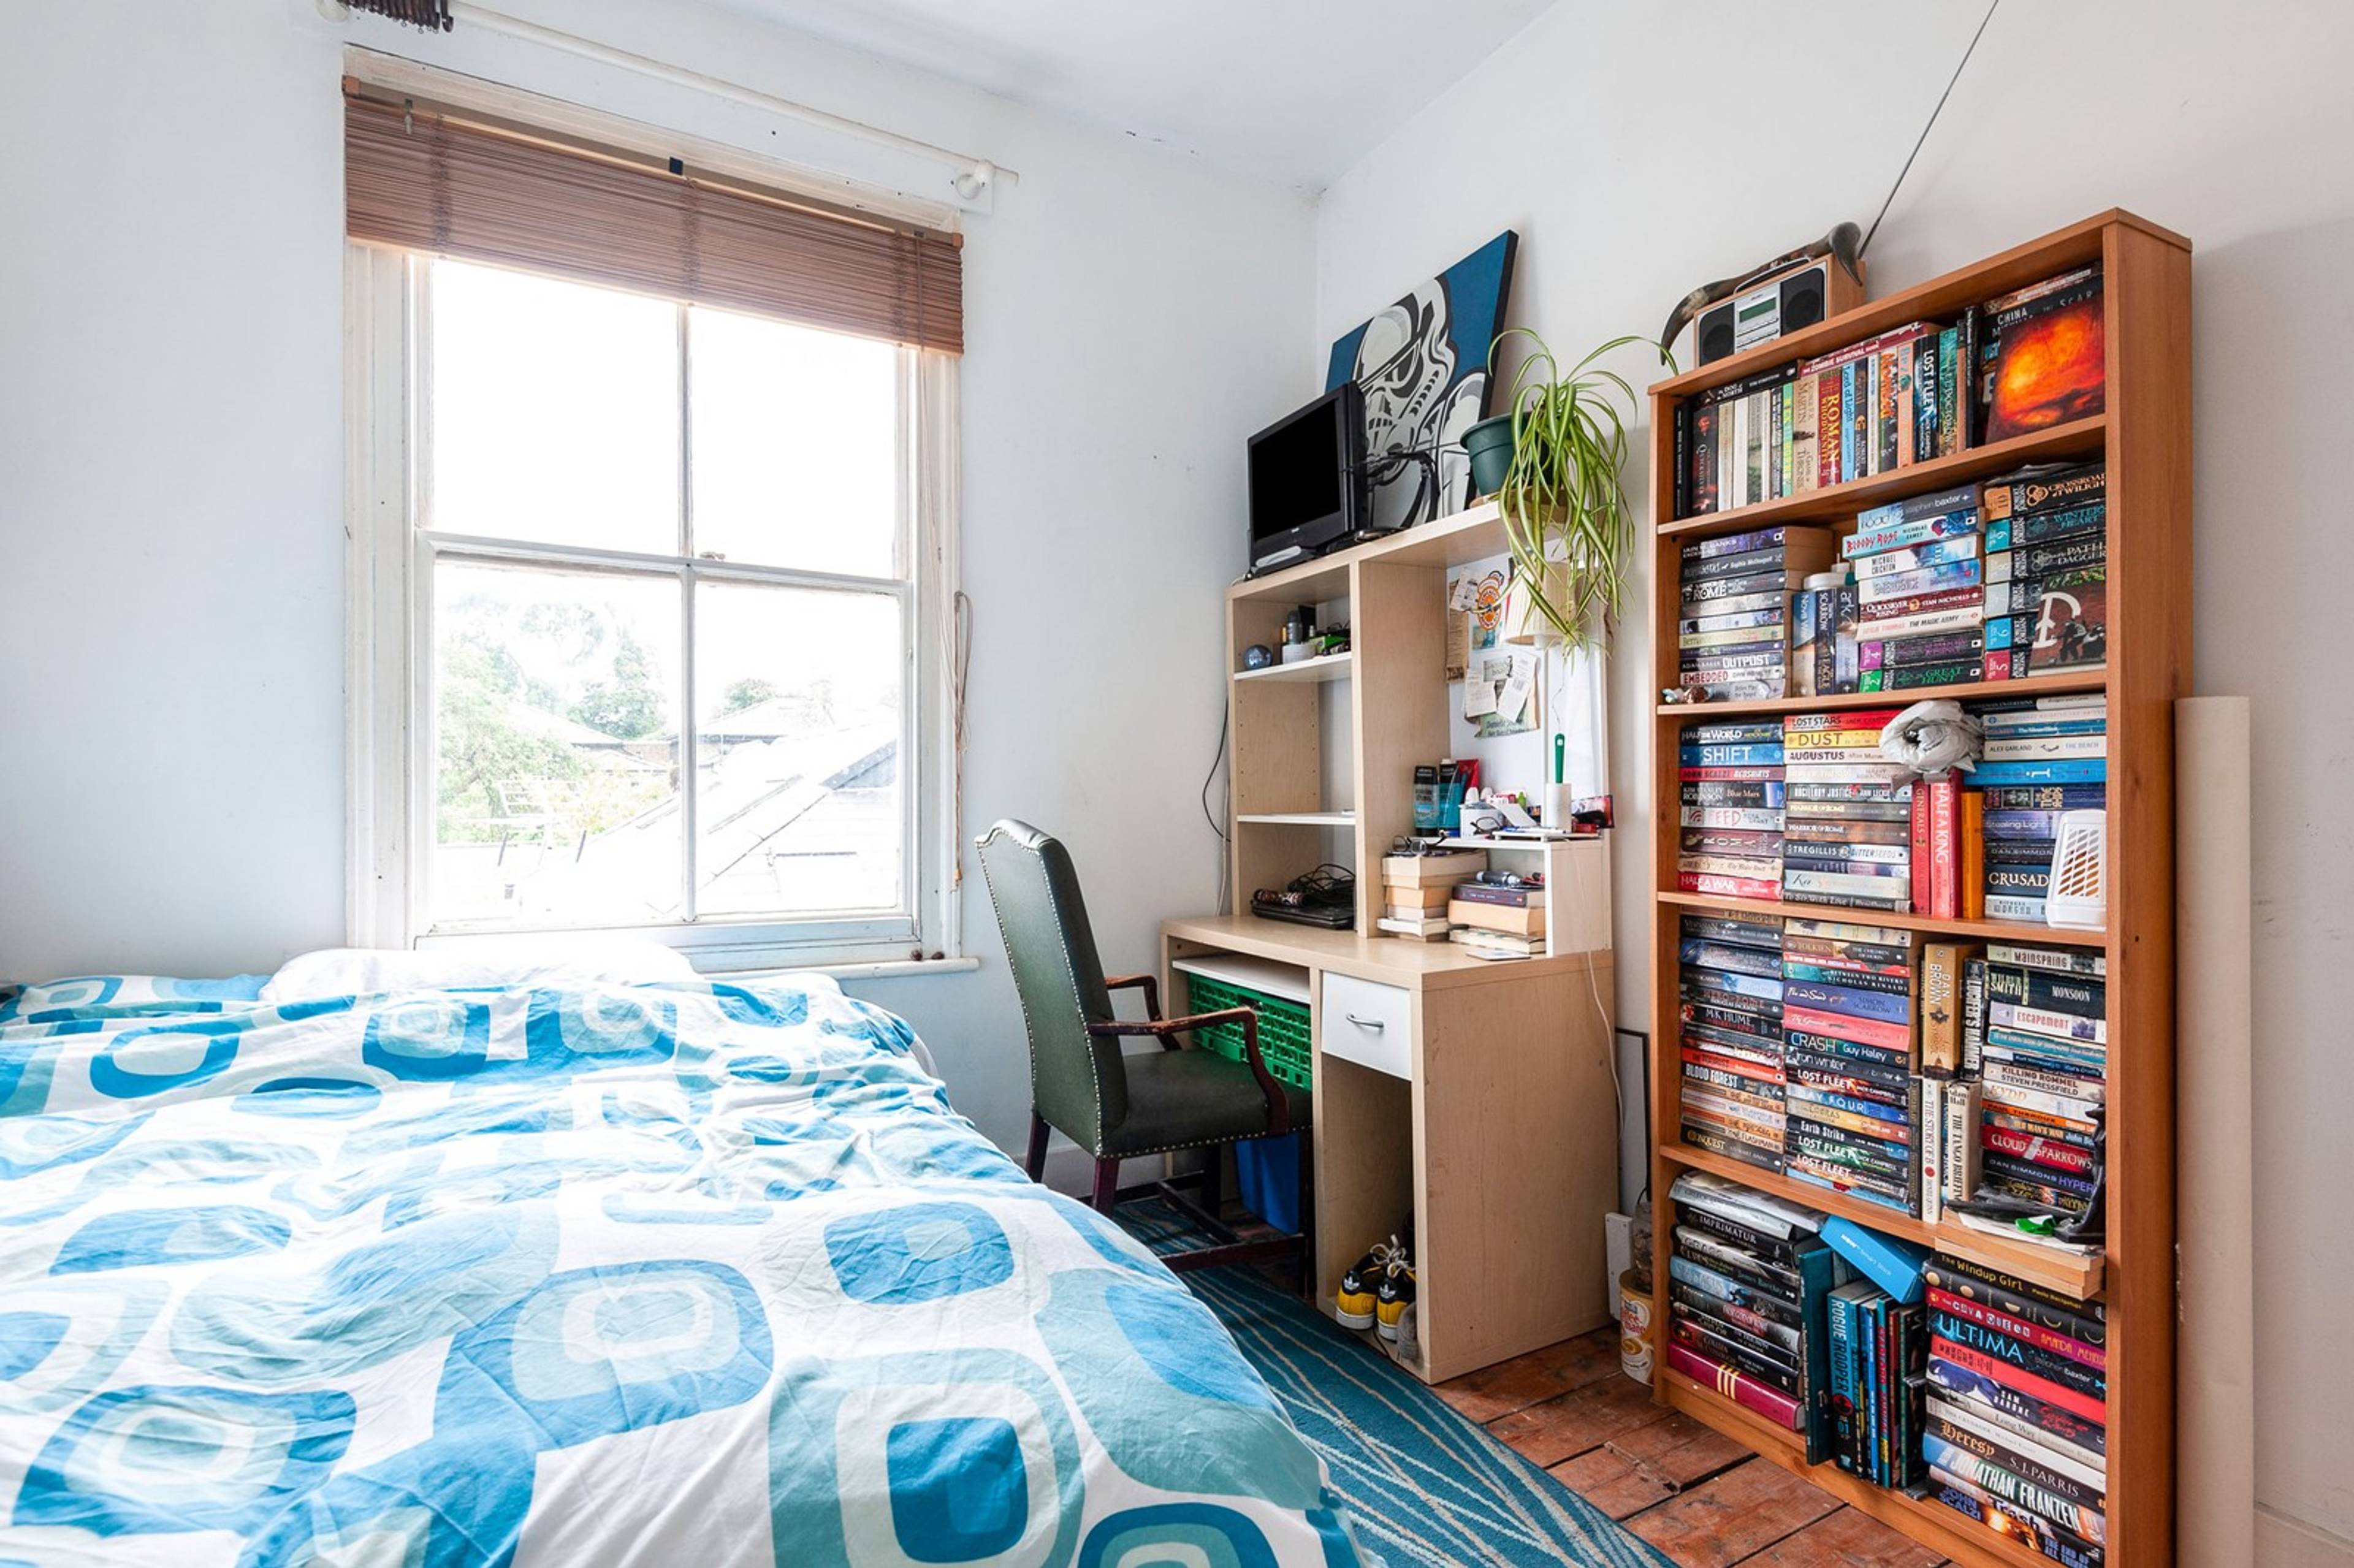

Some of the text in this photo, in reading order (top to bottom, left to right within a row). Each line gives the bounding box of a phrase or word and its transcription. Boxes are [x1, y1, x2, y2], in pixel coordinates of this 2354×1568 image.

[1997, 307, 2028, 325] CHINA
[1923, 349, 1936, 413] LOST FLEET
[1797, 382, 1808, 424] MARTIN
[1843, 398, 1854, 423] Light
[1821, 396, 1829, 464] WHODUNNITS
[1827, 394, 1840, 461] ROMAN
[1797, 448, 1807, 489] THRONES
[1934, 493, 1961, 508] baxter
[1709, 539, 1737, 549] BANKS
[1846, 535, 1875, 555] BLOODY
[1876, 530, 1899, 546] ROSE
[2066, 542, 2103, 556] PATH
[1693, 583, 1727, 601] ROME
[1840, 592, 1855, 614] ark
[1819, 592, 1829, 631] SCARROW
[1909, 619, 1921, 629] THE
[1723, 653, 1771, 669] OUTPOST
[1925, 666, 1962, 677] GREAT
[1683, 671, 1729, 685] EMBEDDED
[1792, 715, 1842, 728] LOST STARS
[1711, 728, 1743, 741] WORLD
[1798, 733, 1843, 747] DUST
[1703, 746, 1753, 763] SHIFT
[1789, 751, 1845, 761] AUGUSTUS
[2005, 744, 2033, 752] GARLAND
[1742, 788, 1761, 798] Mars
[1916, 788, 1925, 834] GENERALS
[1935, 782, 1949, 863] HALF A KING
[1793, 844, 1837, 856] TREGILLIS
[1712, 877, 1737, 892] WAR
[1989, 872, 2050, 887] CRUSAD
[1829, 896, 1848, 907] Love
[1797, 942, 1833, 954] TOLKIEN
[1827, 975, 1870, 988] NICHOLAS
[1830, 969, 1904, 985] BETWEEN TWO RIVERS
[1930, 963, 1942, 1006] BROWN
[1942, 973, 1951, 999] DAN
[1990, 982, 2091, 1002] SMITH MONSOON
[1964, 980, 1982, 1070] LUCIFER'S HAMMER
[1791, 1032, 1888, 1062] CRASH Guy Haley
[1685, 1063, 1710, 1081] BLOOD
[1709, 1068, 1739, 1089] FOREST
[1797, 1069, 1822, 1083] LOST
[1823, 1072, 1853, 1090] FLEET
[2000, 1073, 2030, 1087] STEVEN
[2030, 1079, 2079, 1096] PRESSFIELD
[2002, 1066, 2079, 1089] KILLING ROMMEL
[1826, 1095, 1866, 1113] FOUR
[1924, 1100, 1934, 1119] THE
[1949, 1096, 1965, 1106] Hall
[1686, 1130, 1726, 1151] CONQUEST
[1800, 1120, 1845, 1142] Earth Strike
[1924, 1119, 1935, 1147] STORY
[1952, 1114, 1964, 1162] THE TANGO
[2066, 1132, 2083, 1144] John
[1797, 1135, 1823, 1150] LOST
[1823, 1140, 1854, 1159] FLEET
[1991, 1133, 2093, 1170] CLOUD SPARROWS
[1797, 1153, 1853, 1178] LOST FLEET
[1989, 1158, 2095, 1194] DAN SIMMONS HYPER
[1699, 1215, 1757, 1245] IMPRIMATUR
[1941, 1254, 2024, 1291] The Windup Girl
[1830, 1299, 1849, 1392] ROGUE TROOPER
[1939, 1313, 2024, 1363] ULTIMA
[2063, 1366, 2092, 1382] baxter
[2000, 1390, 2020, 1404] SAM
[2017, 1423, 2035, 1438] Way
[1941, 1420, 2080, 1498] Heresy PARRIS
[1944, 1485, 1979, 1509] JOHN
[1949, 1452, 2084, 1534] JONATHAN FRANZEN
[1938, 1491, 1983, 1521] SCALZI
[1991, 1494, 2041, 1533] Trash
[2044, 1536, 2059, 1550] THE
